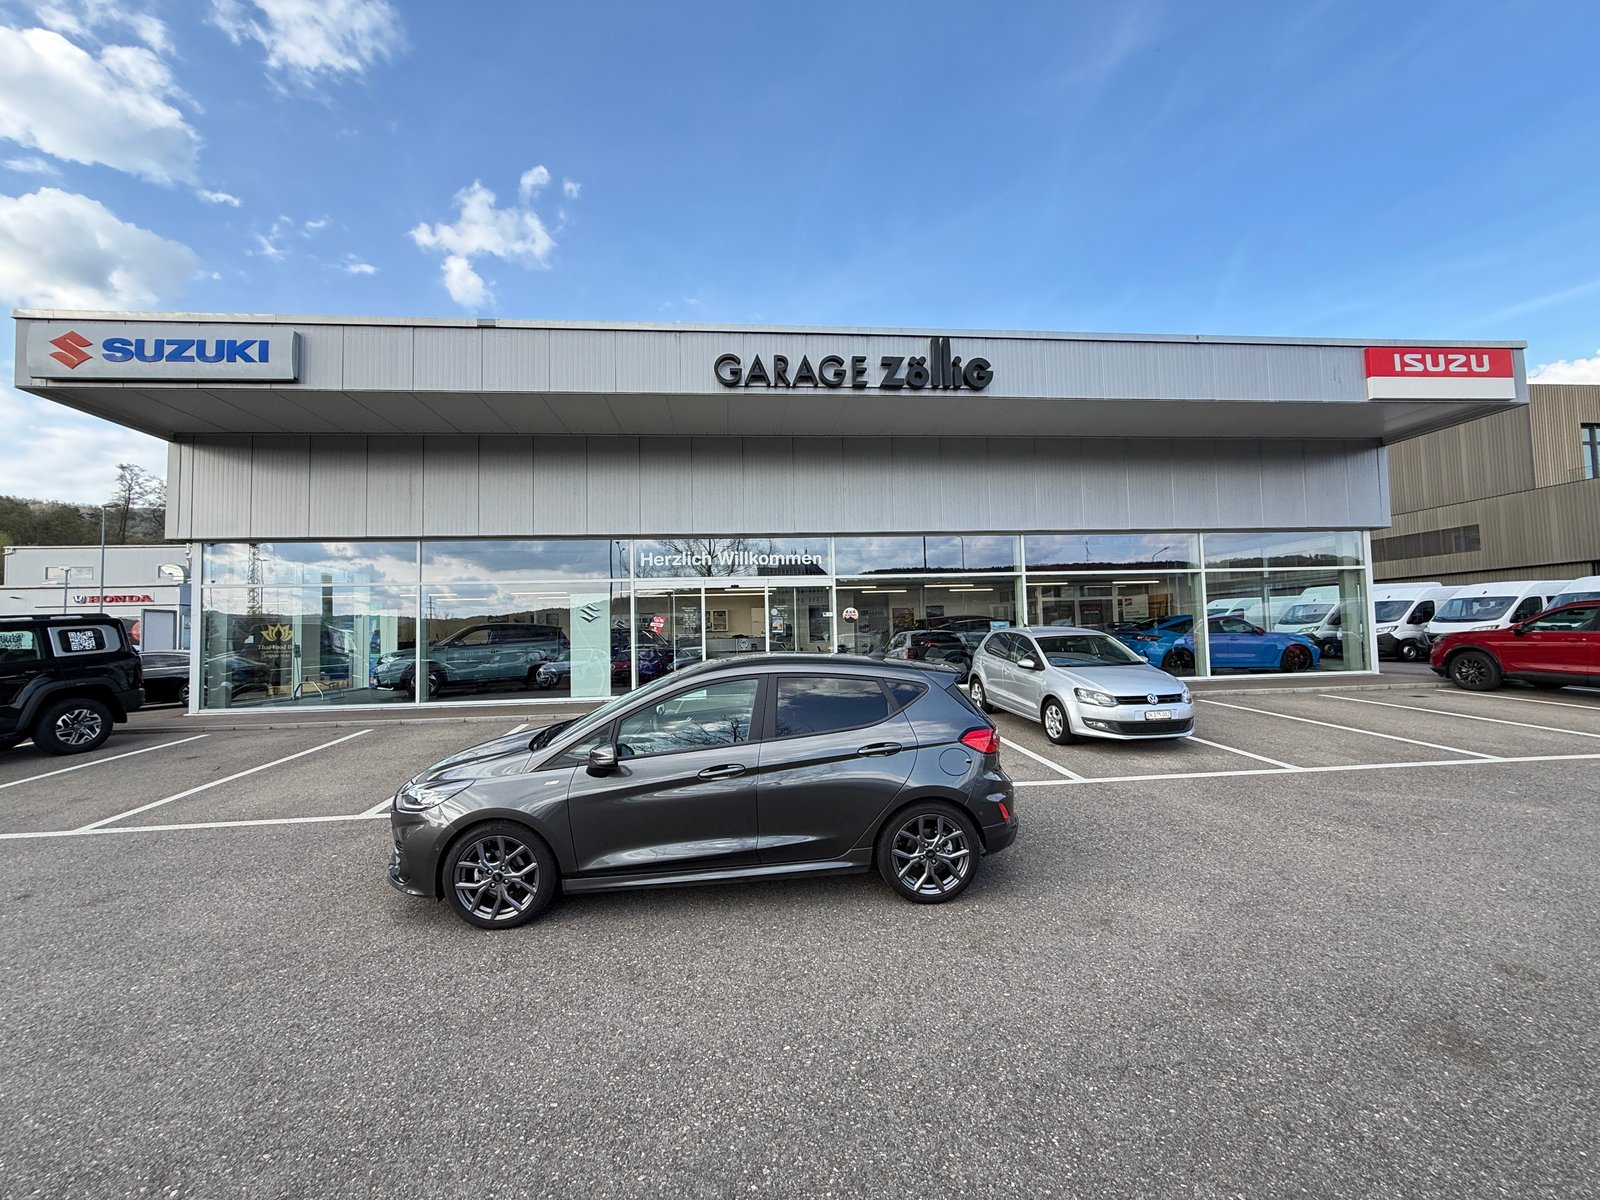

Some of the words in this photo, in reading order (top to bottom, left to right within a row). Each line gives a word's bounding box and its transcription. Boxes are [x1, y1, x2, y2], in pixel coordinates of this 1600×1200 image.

[101, 337, 270, 363] SUZUKI
[713, 353, 868, 388] GARAGE
[1393, 353, 1490, 373] ISUZU
[640, 552, 712, 567] Herzlich
[718, 552, 822, 566] Willkommen
[86, 594, 155, 604] HONDA
